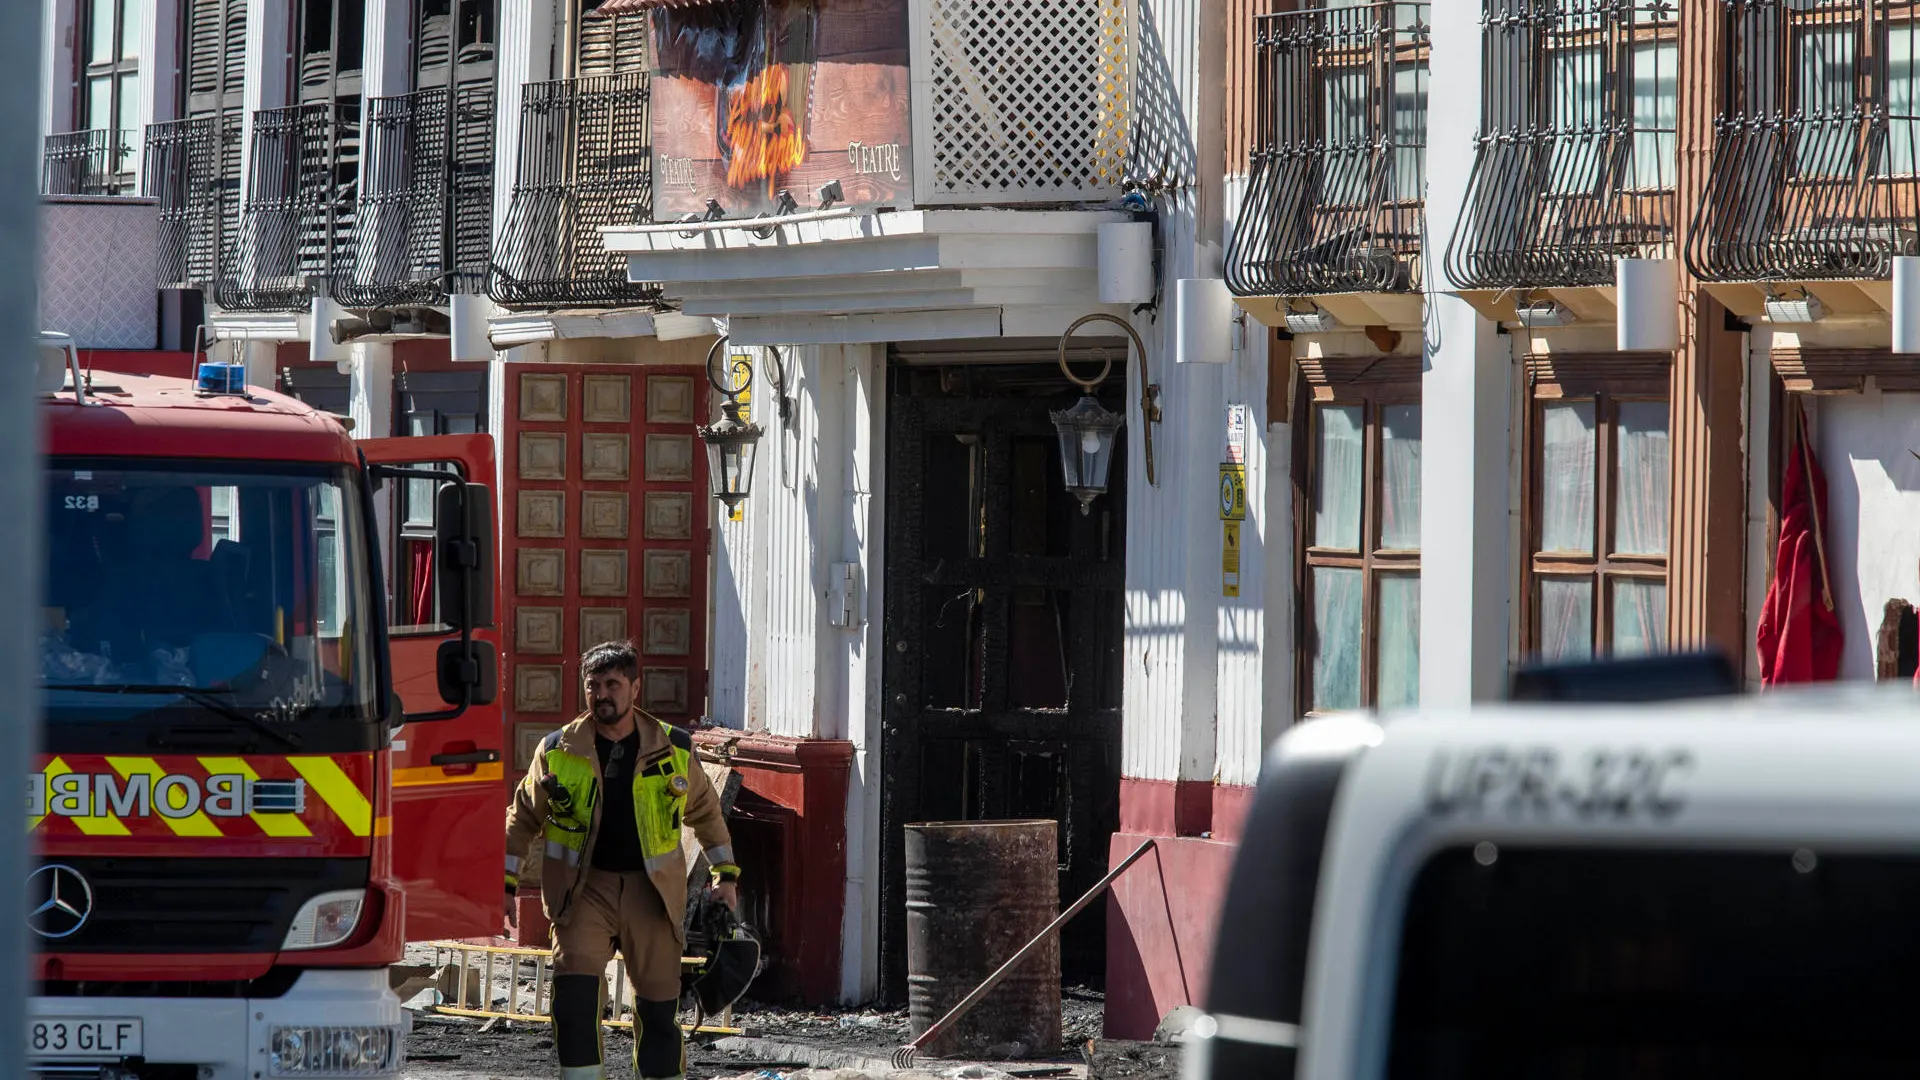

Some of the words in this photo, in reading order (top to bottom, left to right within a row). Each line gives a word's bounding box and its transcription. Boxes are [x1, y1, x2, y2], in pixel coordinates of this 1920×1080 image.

[660, 153, 697, 194] TEATRE
[848, 140, 901, 181] TEATRE
[77, 1023, 132, 1050] GLF
